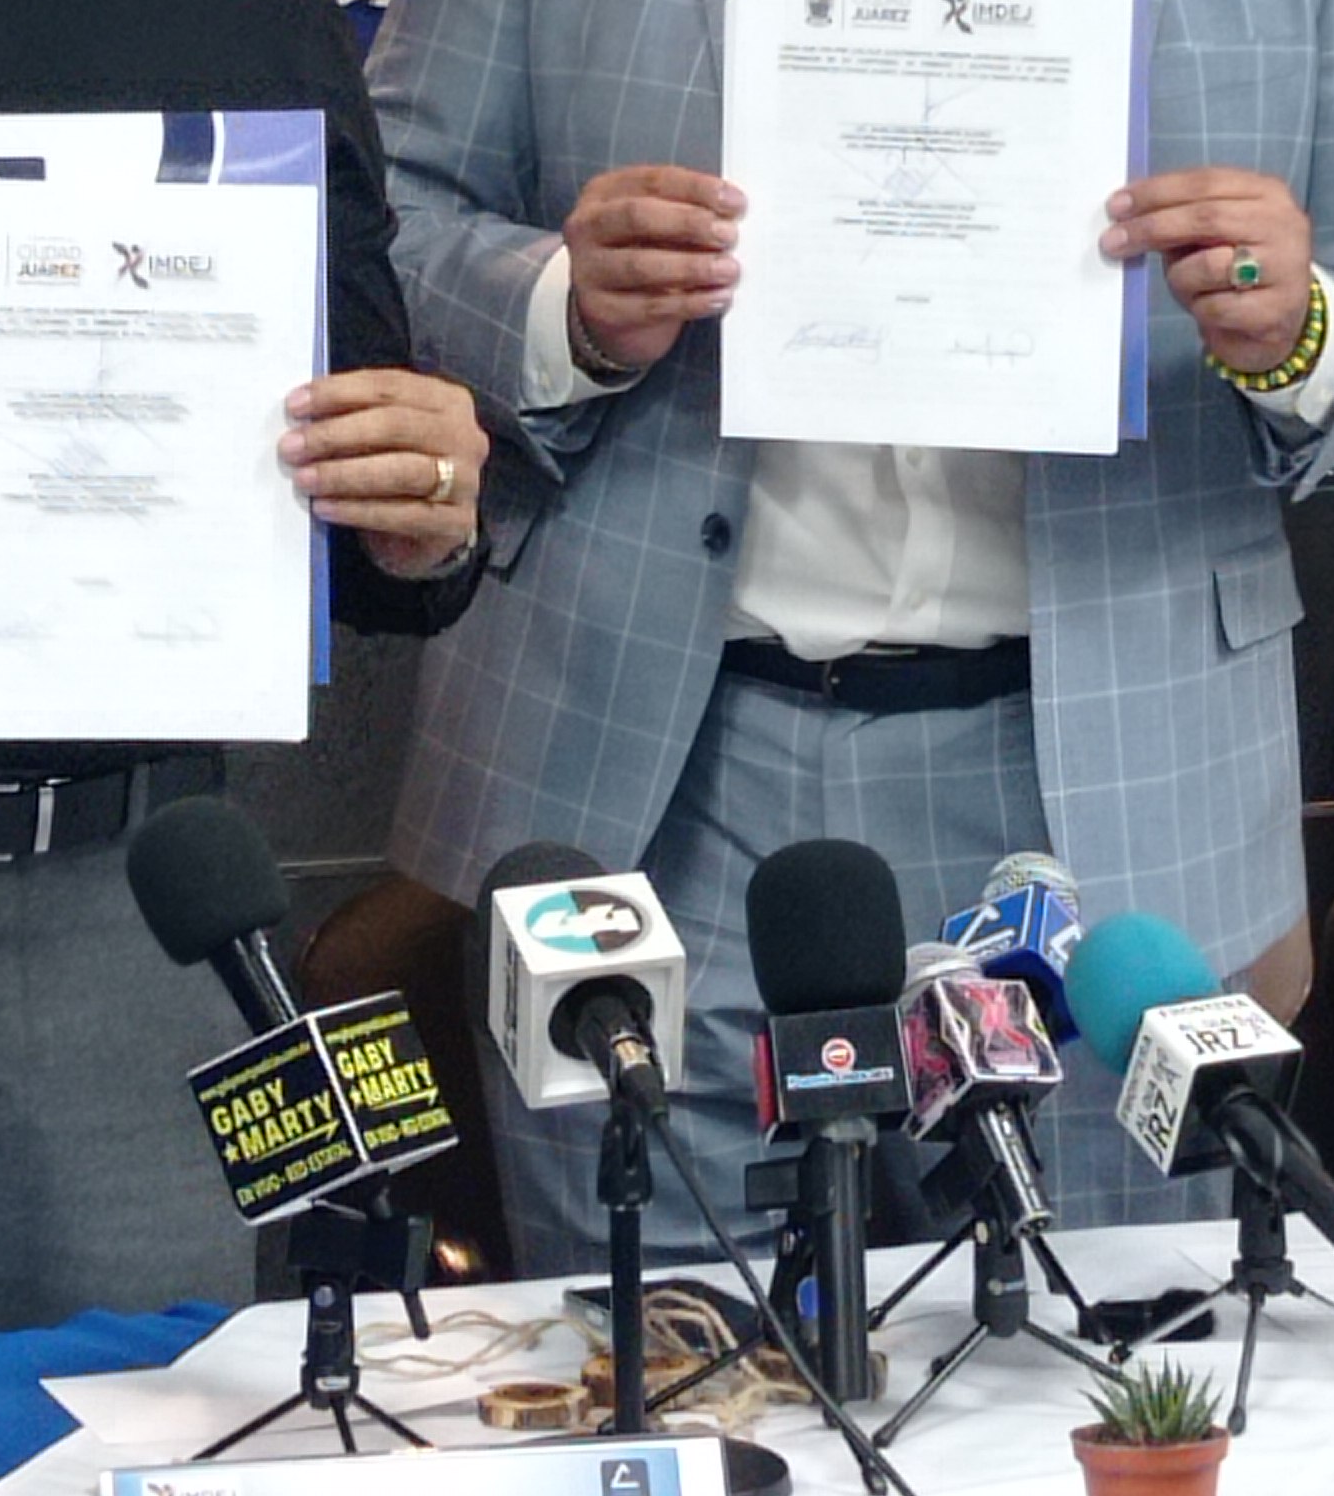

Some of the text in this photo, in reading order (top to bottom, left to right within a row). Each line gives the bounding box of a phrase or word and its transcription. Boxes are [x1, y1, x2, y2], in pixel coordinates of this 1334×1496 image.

[973, 3, 1033, 24] IMDEJ
[148, 255, 213, 275] IMDEJ
[335, 1036, 395, 1080] GABY
[359, 1058, 434, 1106] MARTY
[210, 1077, 285, 1136] GABY
[238, 1089, 334, 1161] MARTY
